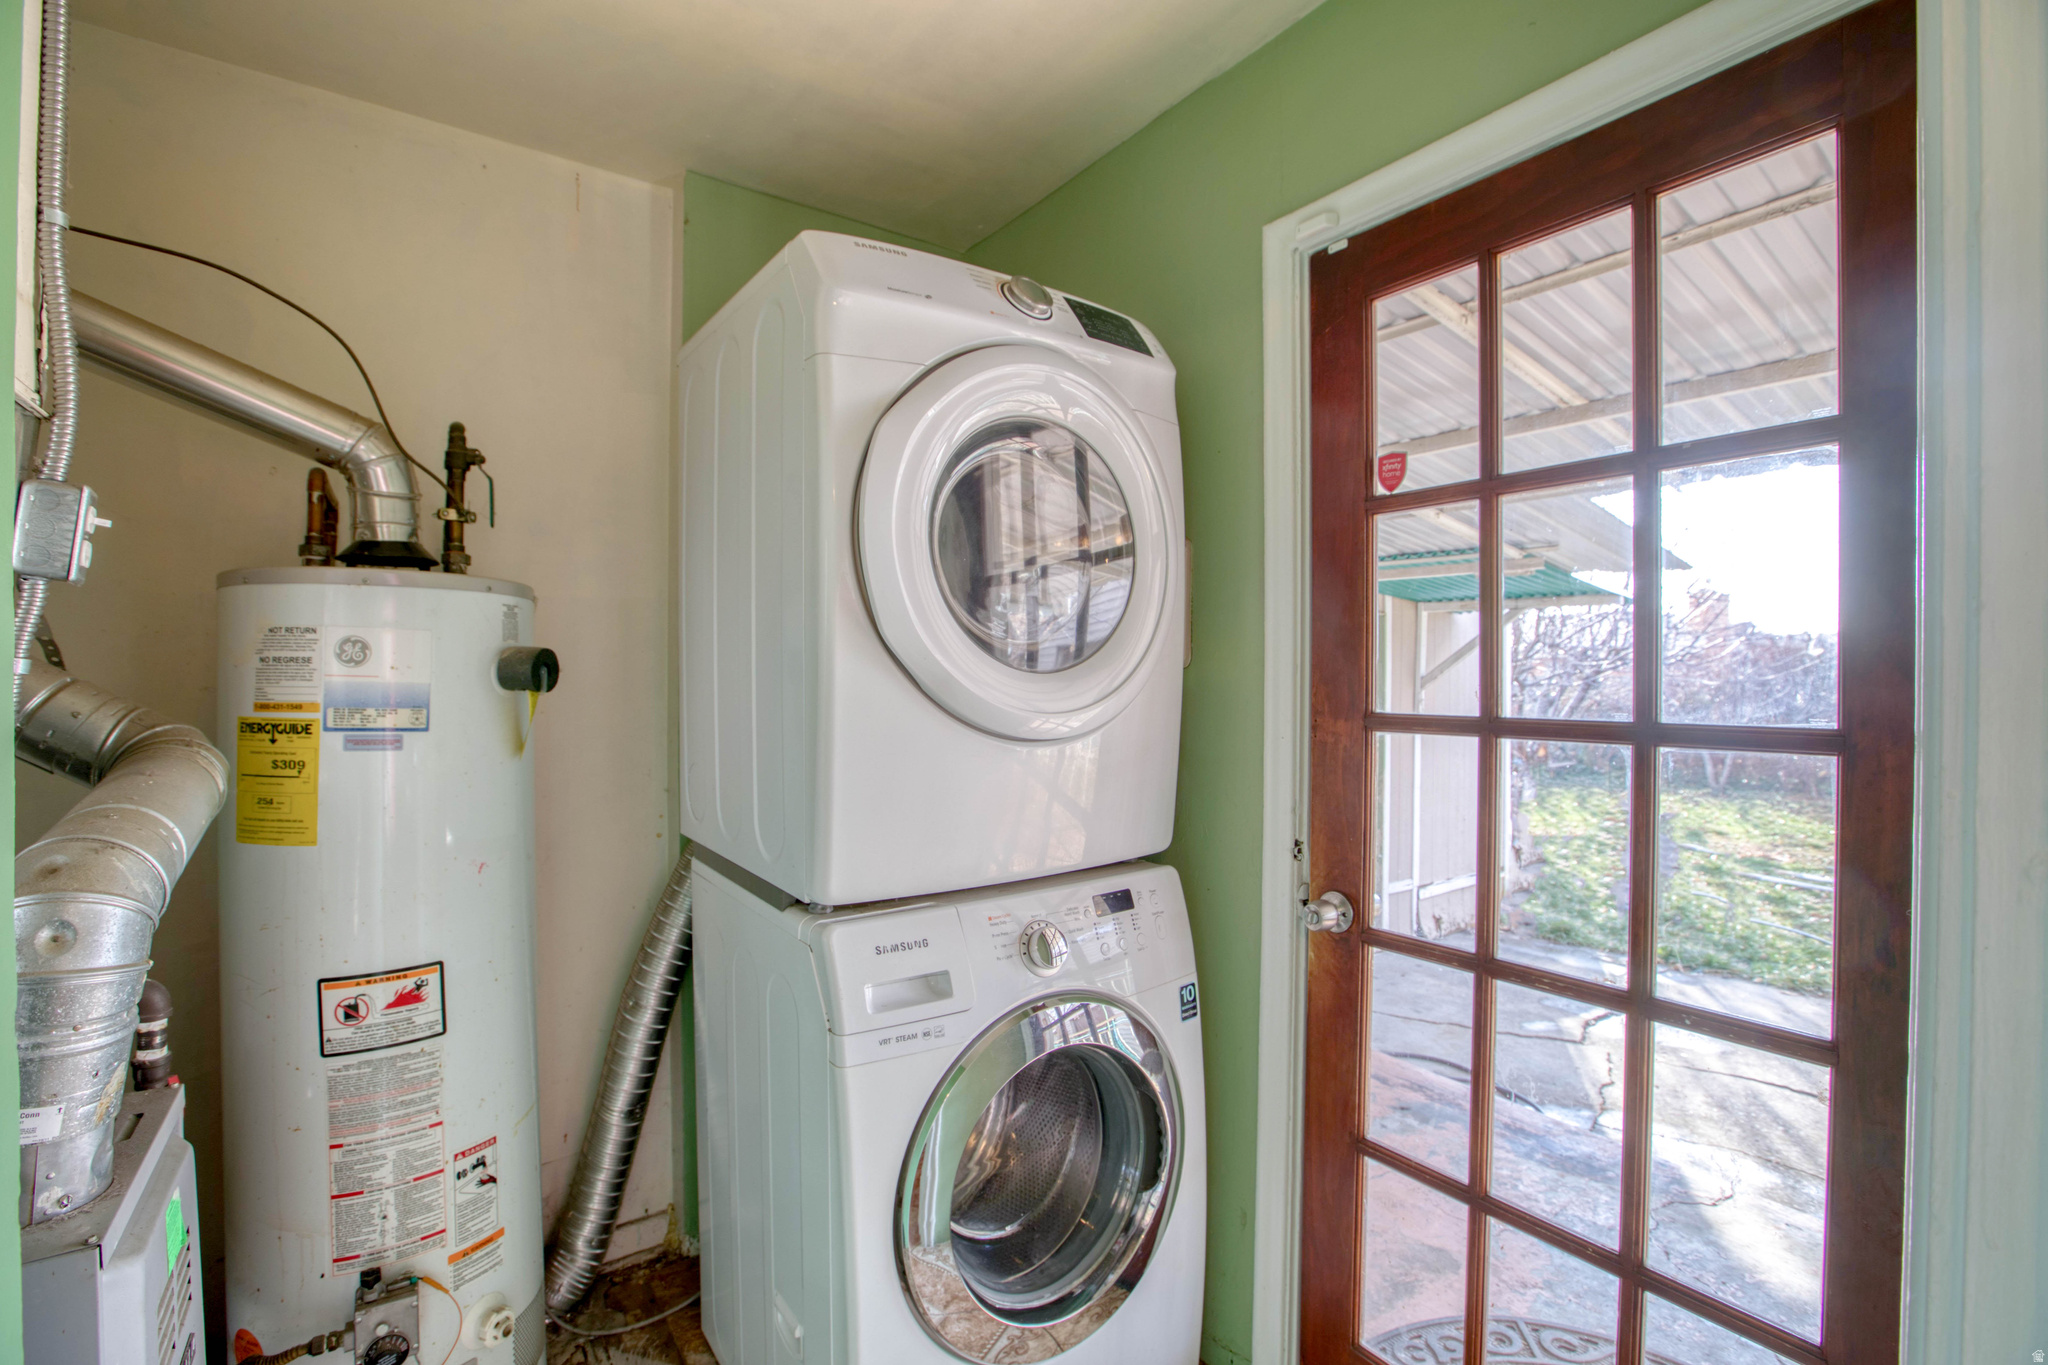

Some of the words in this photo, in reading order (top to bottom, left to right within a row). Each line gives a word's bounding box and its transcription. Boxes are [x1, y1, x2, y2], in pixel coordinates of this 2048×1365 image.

[853, 241, 908, 257] SAMSUNG
[1382, 470, 1401, 478] home
[259, 656, 271, 664] NO
[272, 656, 313, 664] REGRESE
[271, 759, 306, 770] $309
[875, 938, 929, 956] SAMSUNG
[365, 973, 408, 985] WARNING
[1181, 985, 1195, 1003] 10
[878, 1038, 891, 1046] VRT
[895, 1032, 918, 1043] STEAM
[464, 1139, 495, 1157] DANGER
